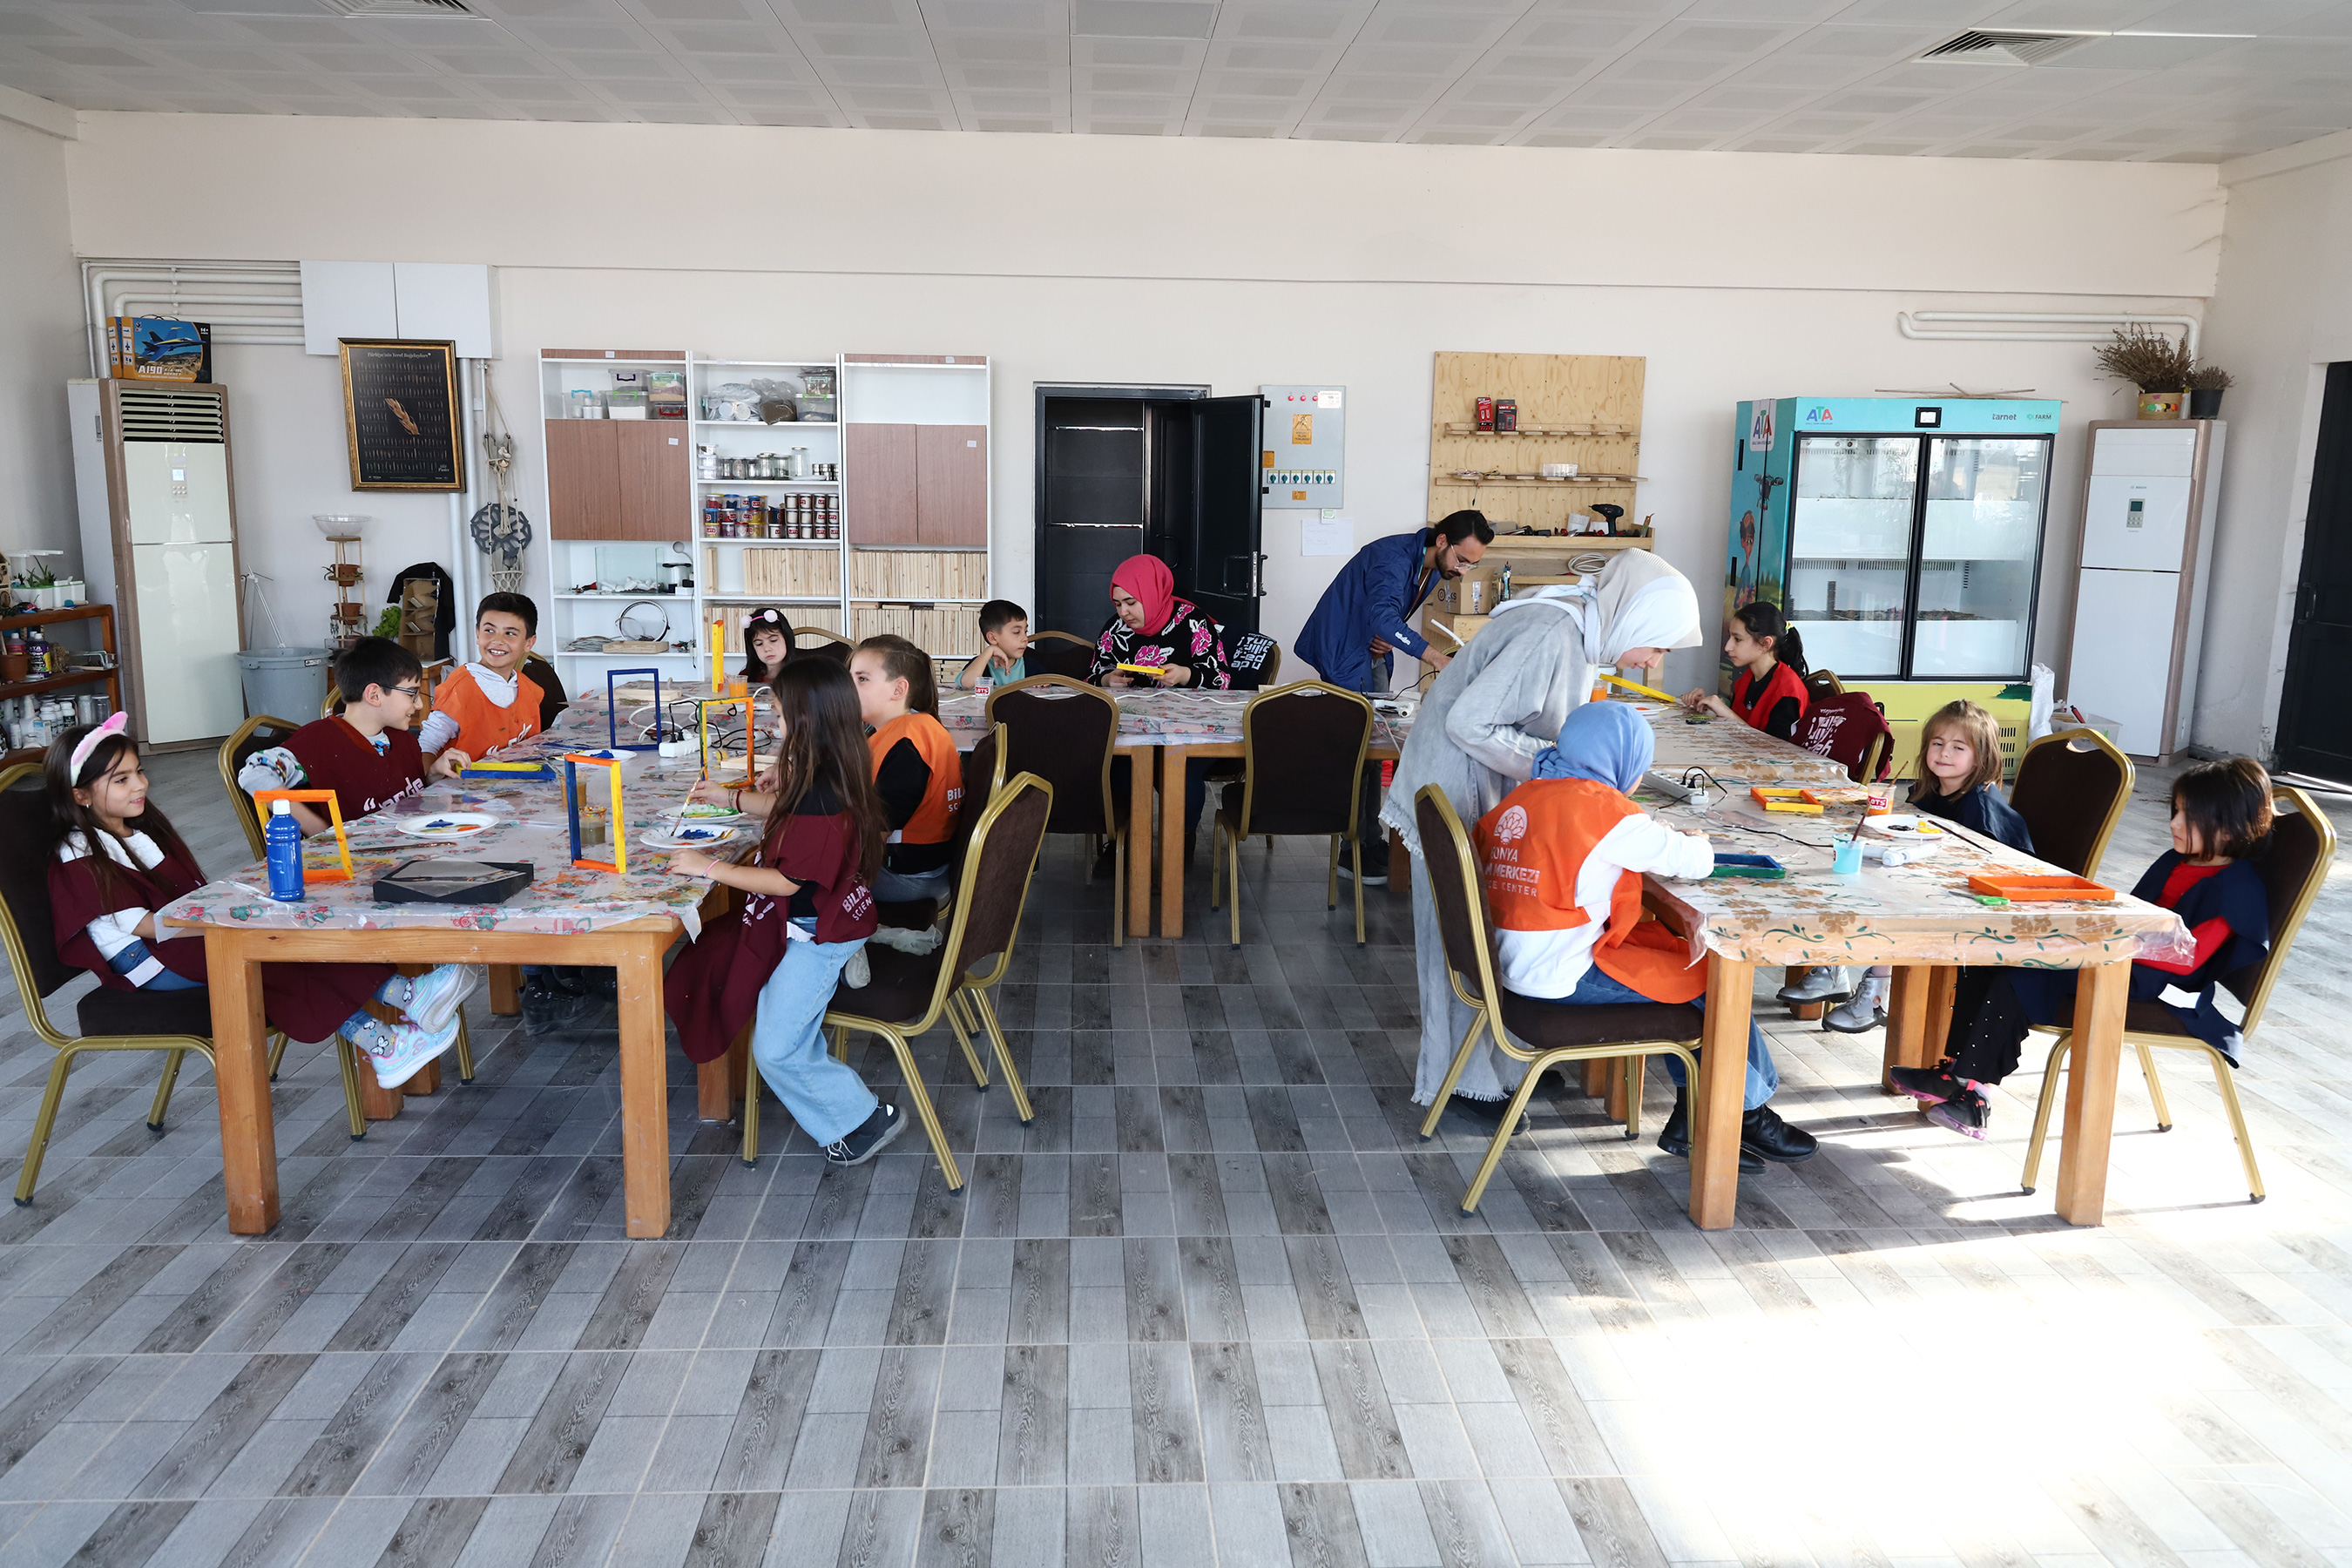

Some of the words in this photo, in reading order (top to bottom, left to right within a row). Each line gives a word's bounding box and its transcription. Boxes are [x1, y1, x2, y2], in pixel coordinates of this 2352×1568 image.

[139, 366, 162, 375] A190
[1806, 406, 1834, 422] ATA
[1753, 409, 1772, 439] ATA
[1502, 882, 1538, 896] CENTER
[852, 897, 874, 922] SCIEN
